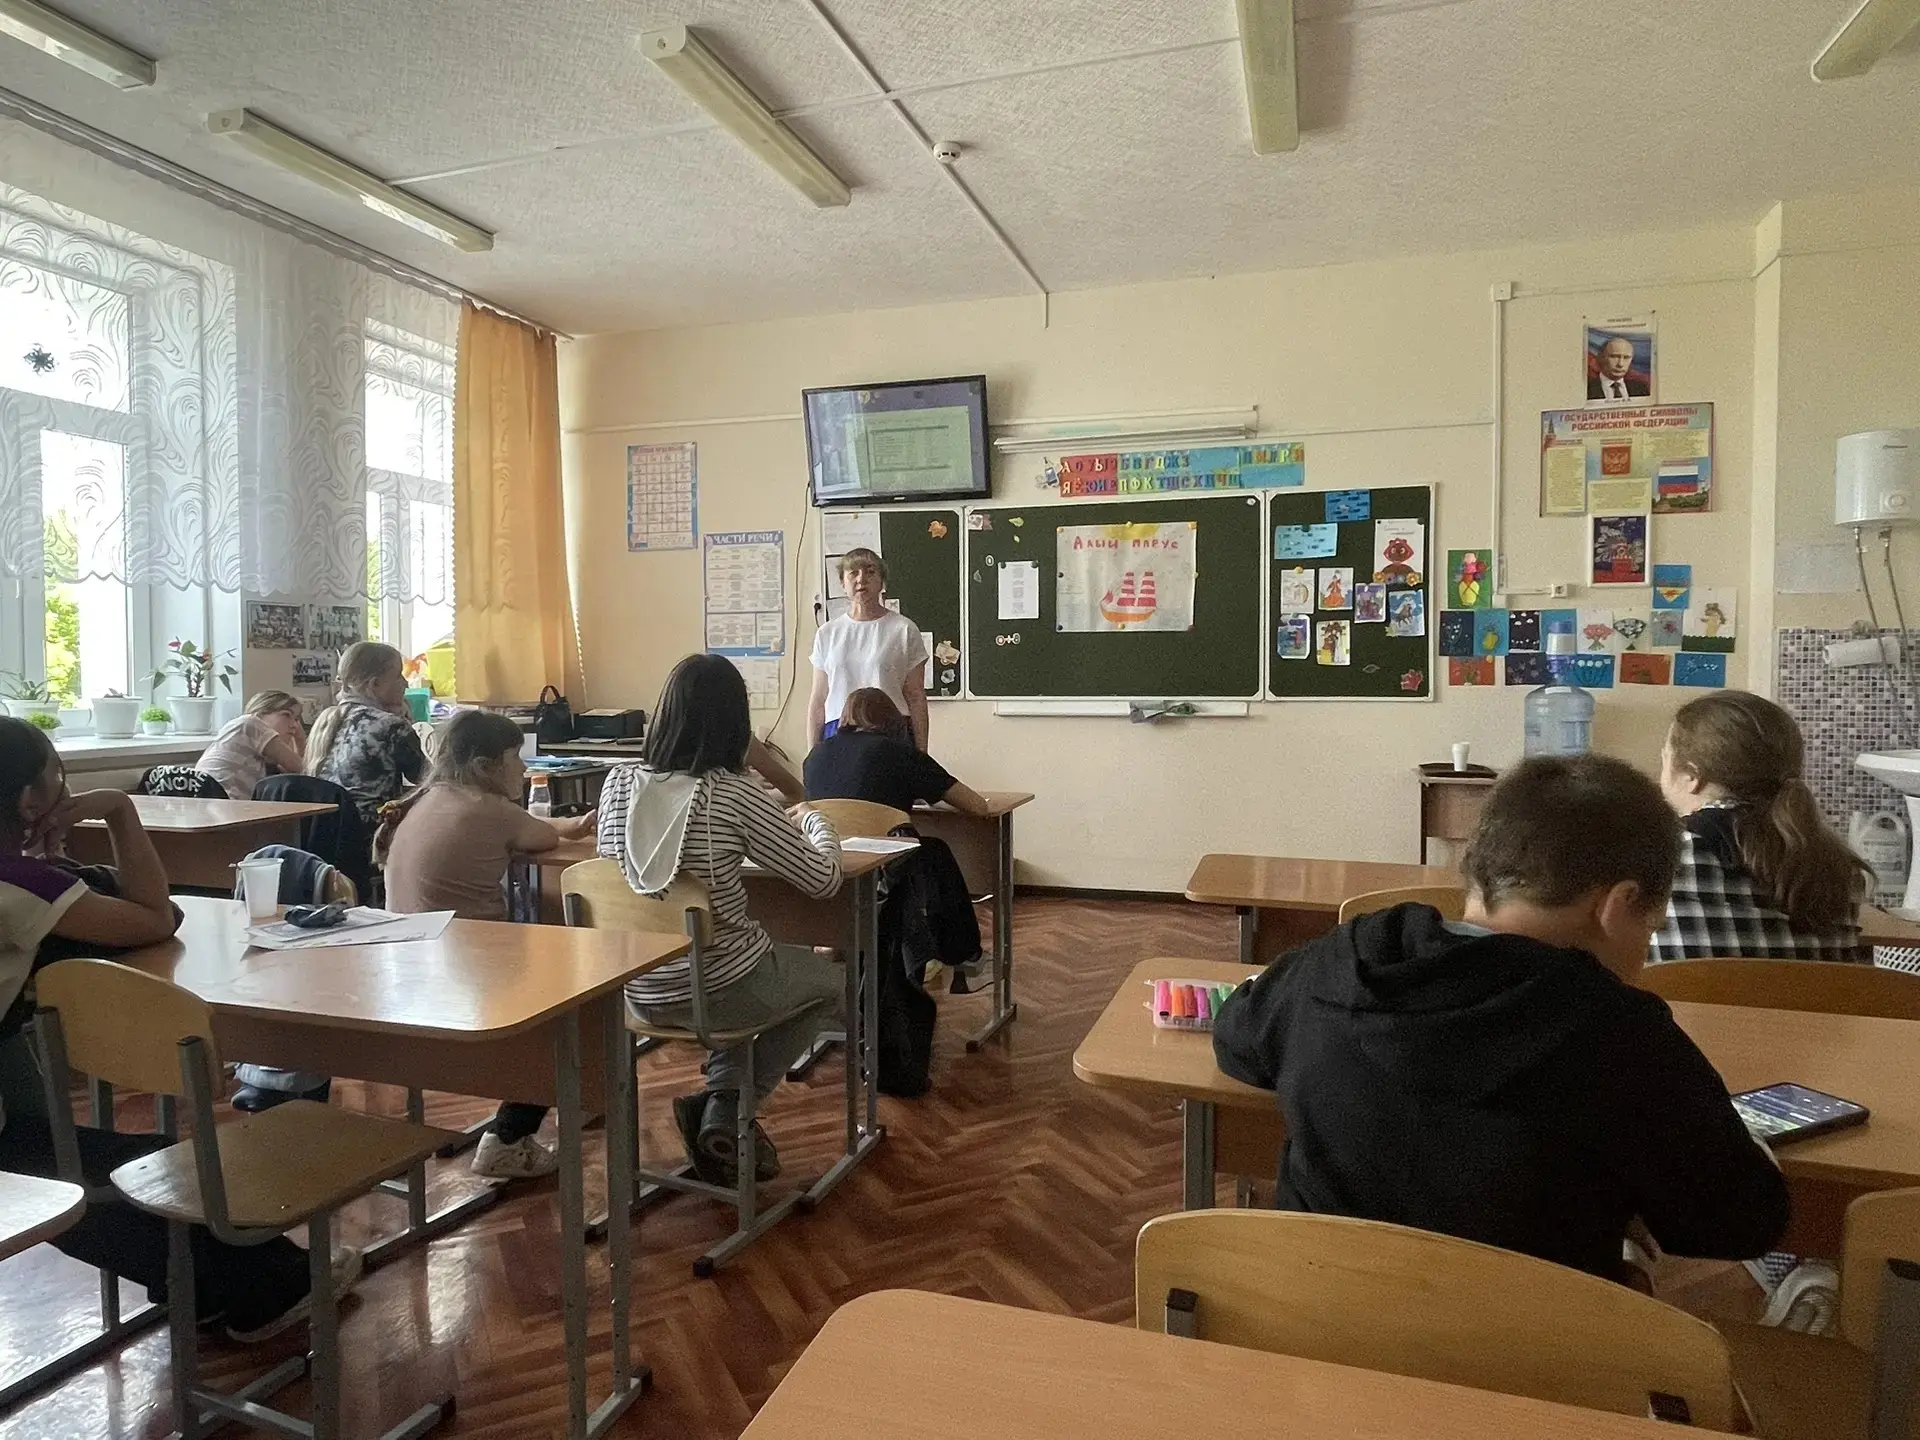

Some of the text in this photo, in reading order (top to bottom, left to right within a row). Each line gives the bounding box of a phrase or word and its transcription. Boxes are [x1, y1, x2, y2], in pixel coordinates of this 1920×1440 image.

[1559, 407, 1698, 422] ГОСУДАРСТВЕННЫЕ СИМВОЛЫ
[1571, 417, 1688, 432] РОССИЙСКОЙ ФЕДЕРАЦИИ
[714, 532, 773, 545] ЧАСТИ РЕЧИ
